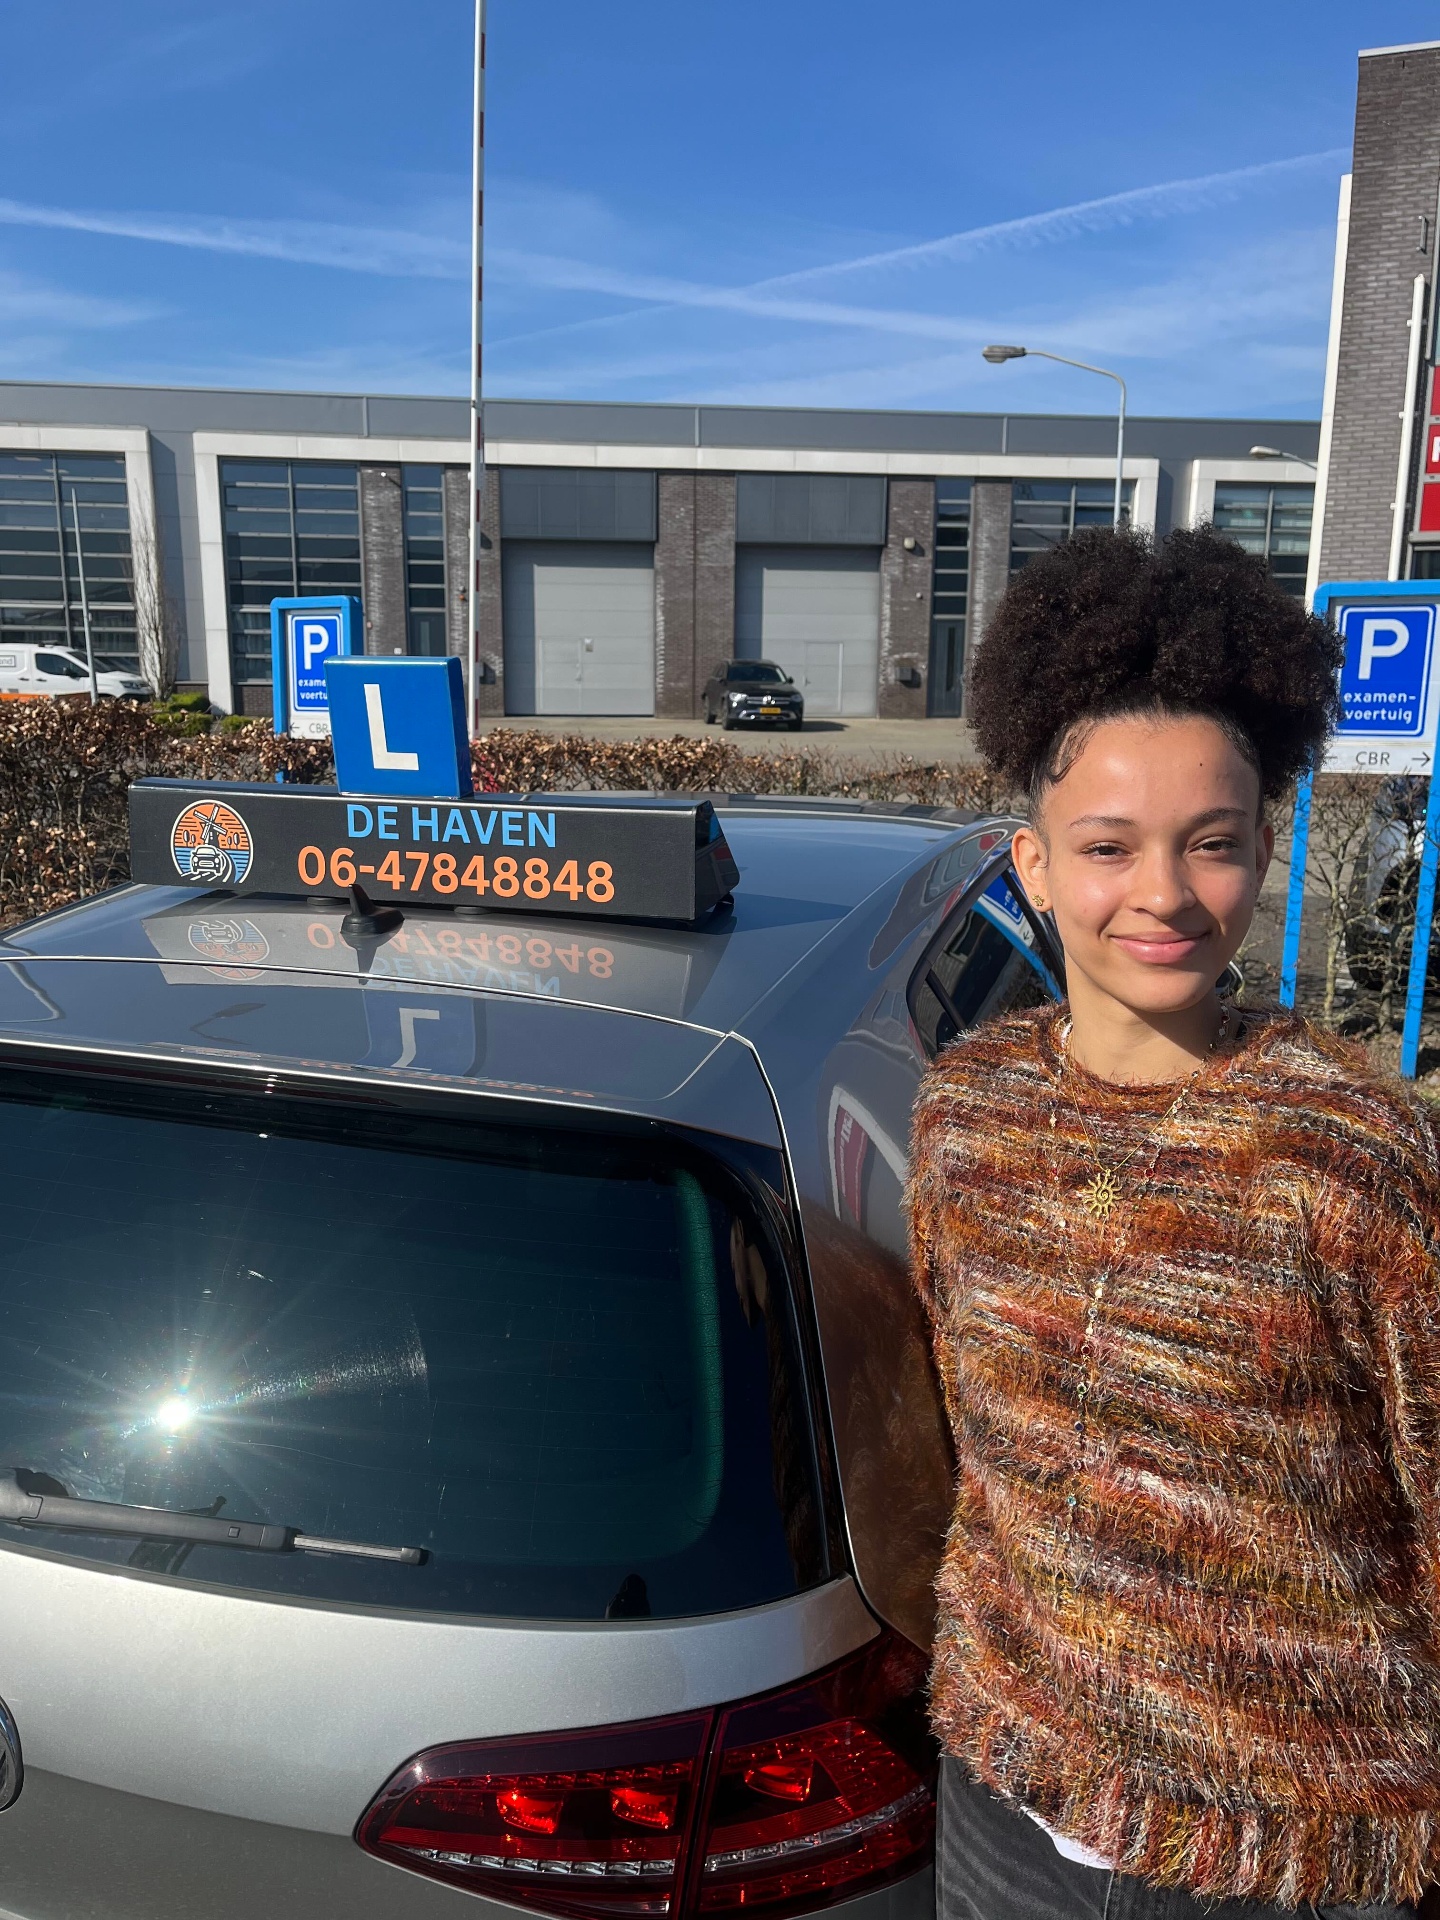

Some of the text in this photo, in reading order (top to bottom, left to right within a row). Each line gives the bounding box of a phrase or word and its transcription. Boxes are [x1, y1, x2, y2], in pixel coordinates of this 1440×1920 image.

[303, 624, 330, 670] P
[1358, 618, 1410, 680] P
[298, 678, 327, 688] exame
[300, 690, 329, 700] voertu
[1343, 691, 1416, 703] examen-
[363, 683, 420, 772] L
[1344, 707, 1413, 725] voertuig
[1355, 750, 1390, 766] CBR
[347, 803, 557, 848] DE HAVEN
[297, 845, 616, 903] 06-47848848
